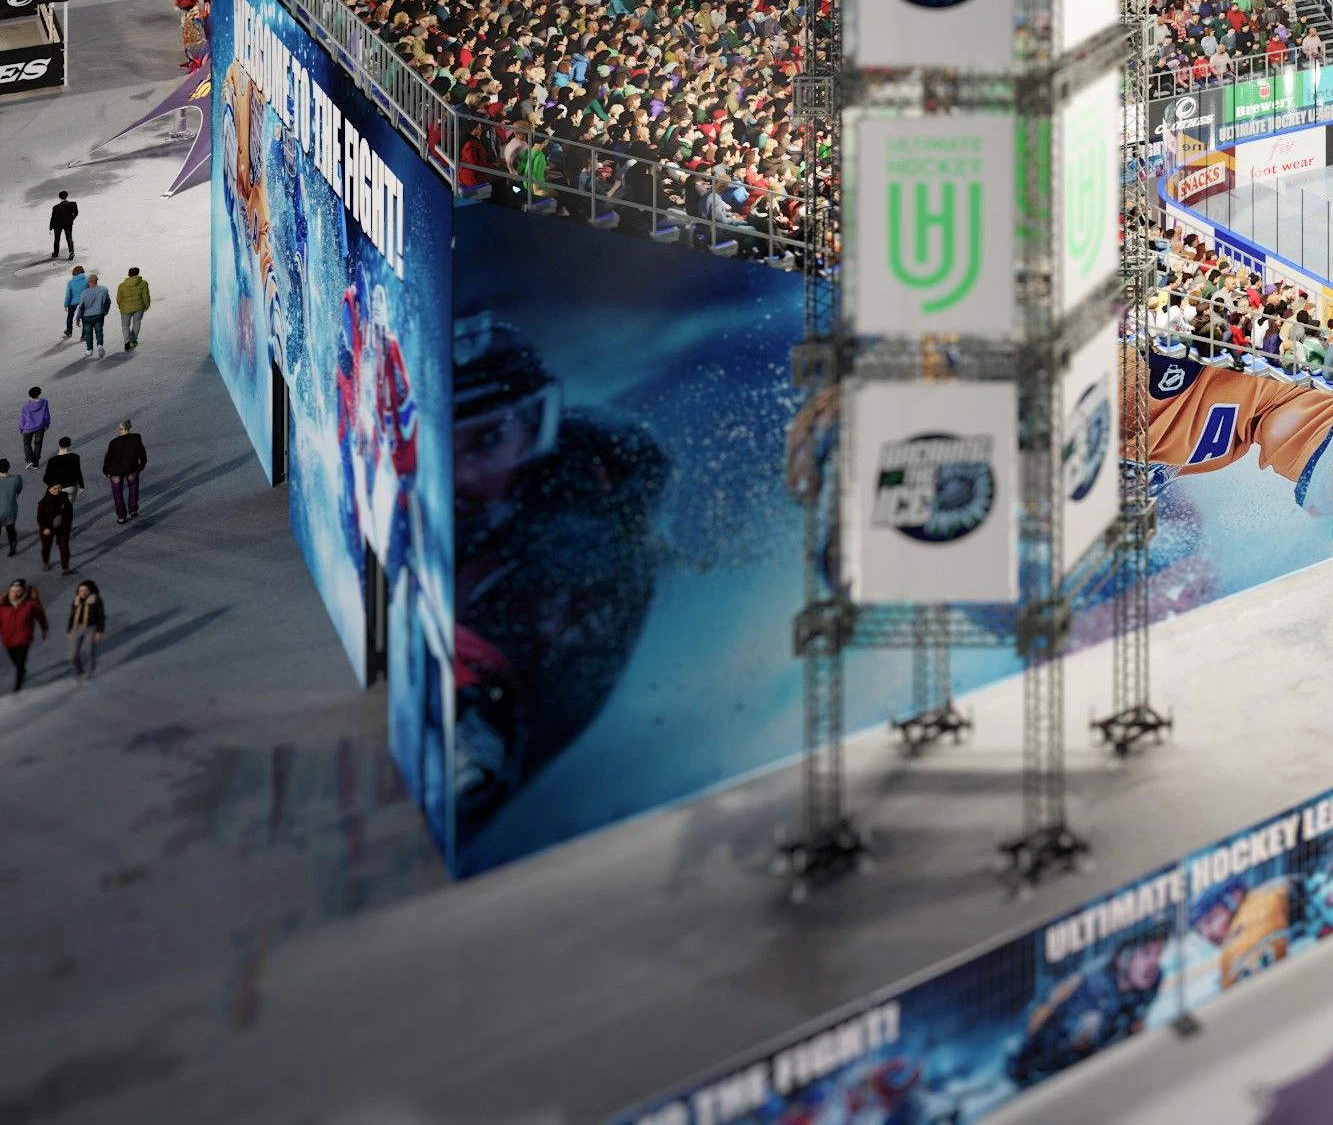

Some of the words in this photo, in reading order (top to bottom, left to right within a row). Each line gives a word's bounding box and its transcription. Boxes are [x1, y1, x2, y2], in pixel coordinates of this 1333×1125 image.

[1236, 97, 1293, 118] Brewery
[1219, 121, 1271, 141] ULTIMATE
[1273, 111, 1307, 131] HOCKEY
[292, 59, 311, 154] TO
[313, 81, 342, 198] THE
[344, 118, 404, 282] FIGHT!
[1282, 156, 1315, 173] wear
[1180, 166, 1220, 198] SNACKS
[1045, 867, 1186, 963] ULTIMATE
[1191, 816, 1300, 889] HOCKEY
